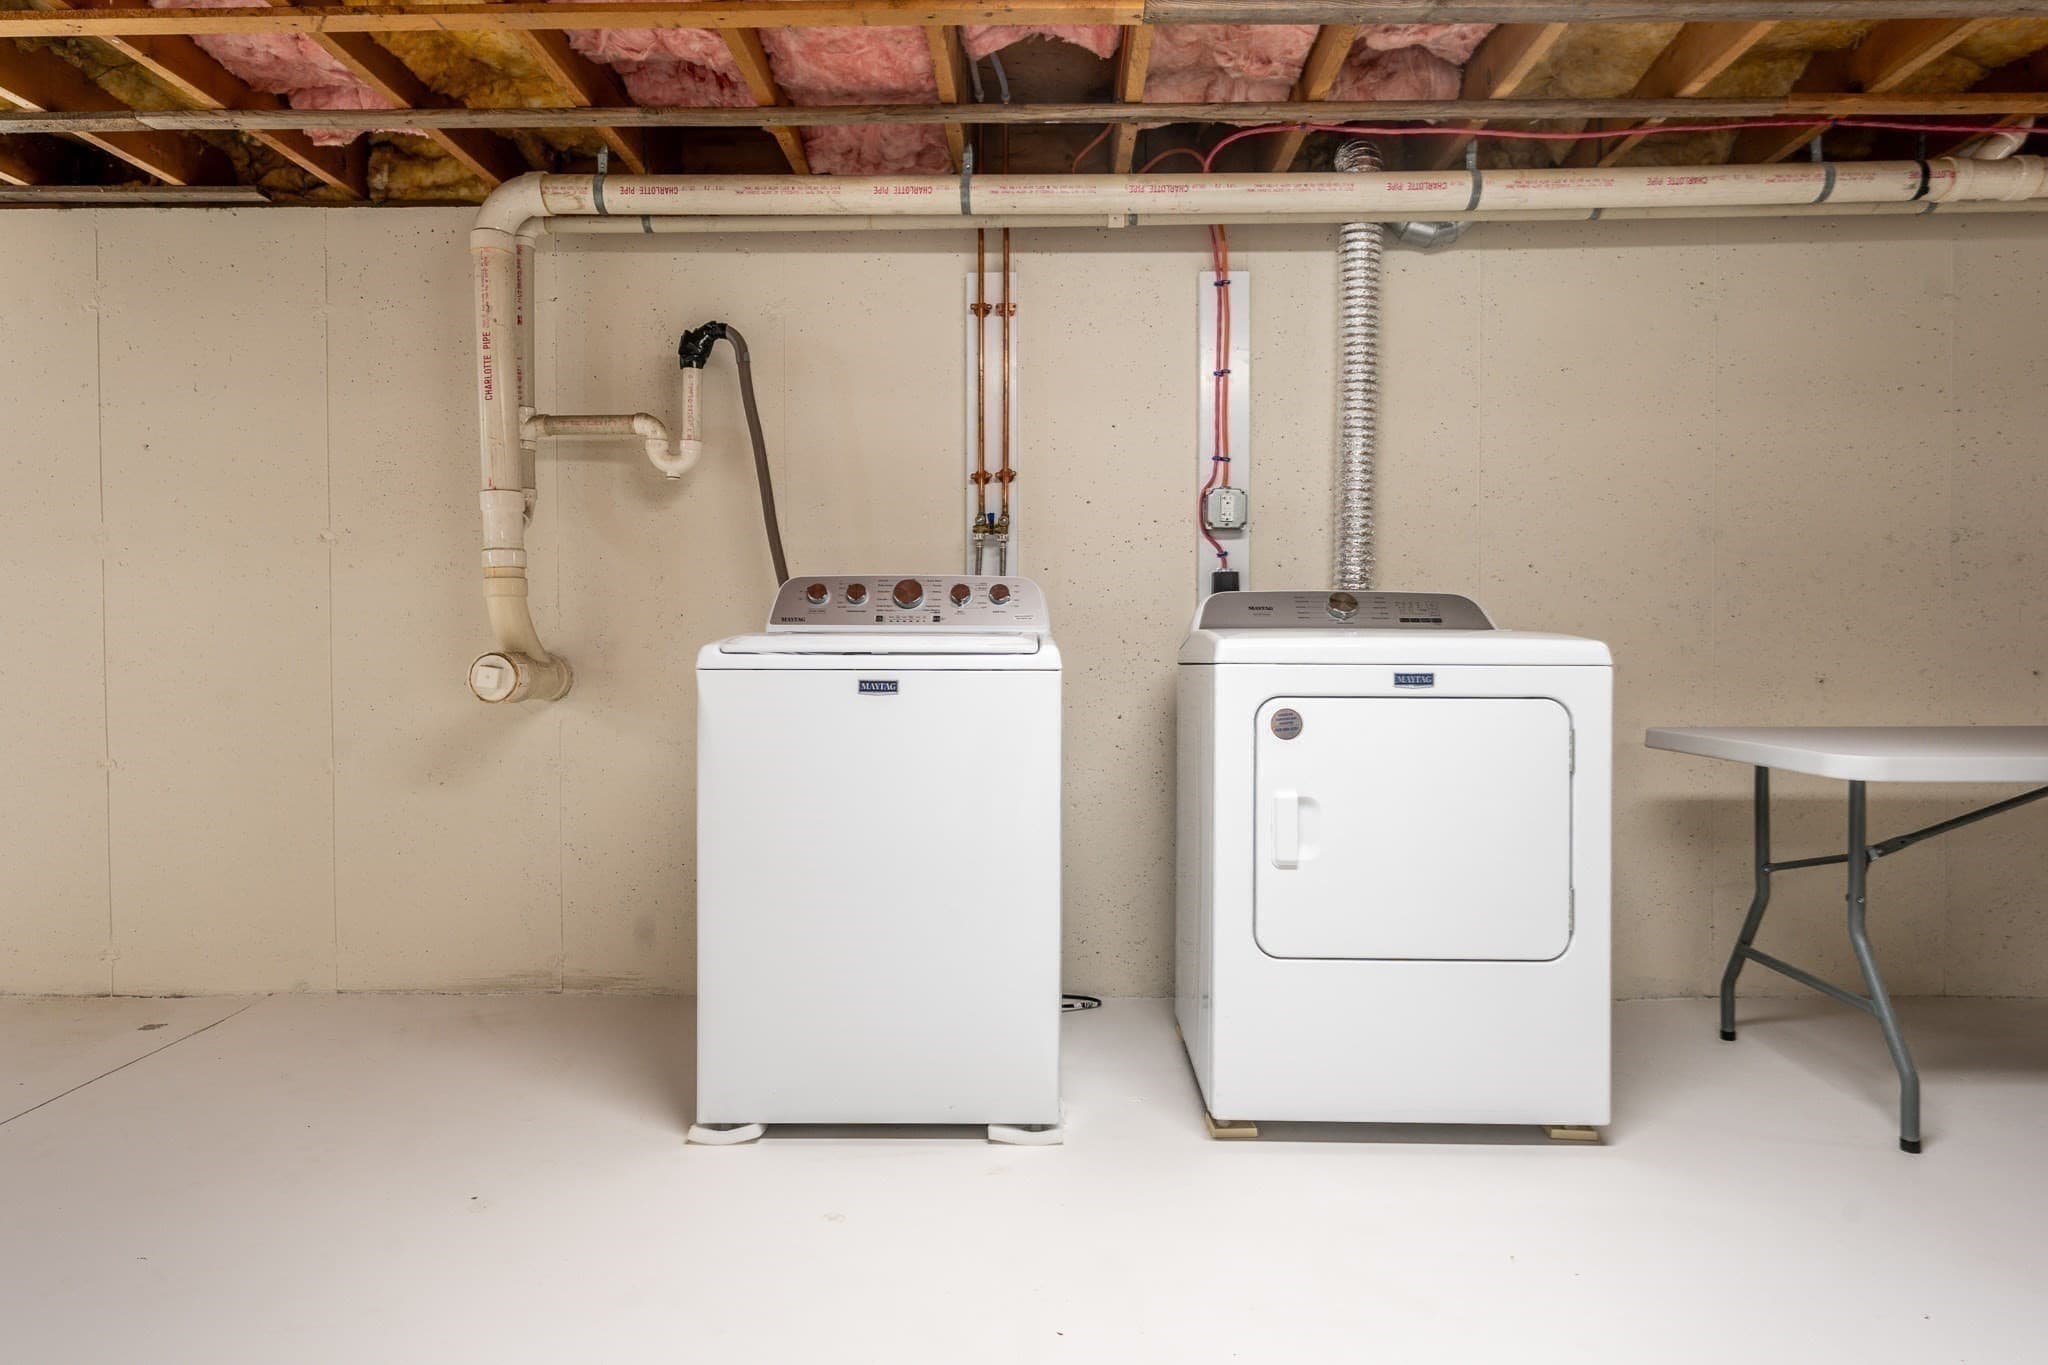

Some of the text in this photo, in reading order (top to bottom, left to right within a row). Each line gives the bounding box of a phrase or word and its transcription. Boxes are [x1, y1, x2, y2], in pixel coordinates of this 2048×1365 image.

[1647, 177, 1664, 186] PIPE
[1666, 175, 1708, 185] CHARLOTTE
[619, 186, 635, 195] PIPE
[640, 186, 679, 195] CHARLOTTE
[873, 185, 933, 195] CHARLOTTE PIPE
[1128, 184, 1145, 193] PIPE
[1148, 184, 1189, 193] CHARLOTTE
[1386, 181, 1448, 191] CHARLOTTE PIPE
[482, 331, 491, 350] PIPE
[483, 354, 493, 401] CHARLOTTE
[1395, 675, 1432, 684] MAYTAG
[860, 682, 897, 690] MAYTAG
